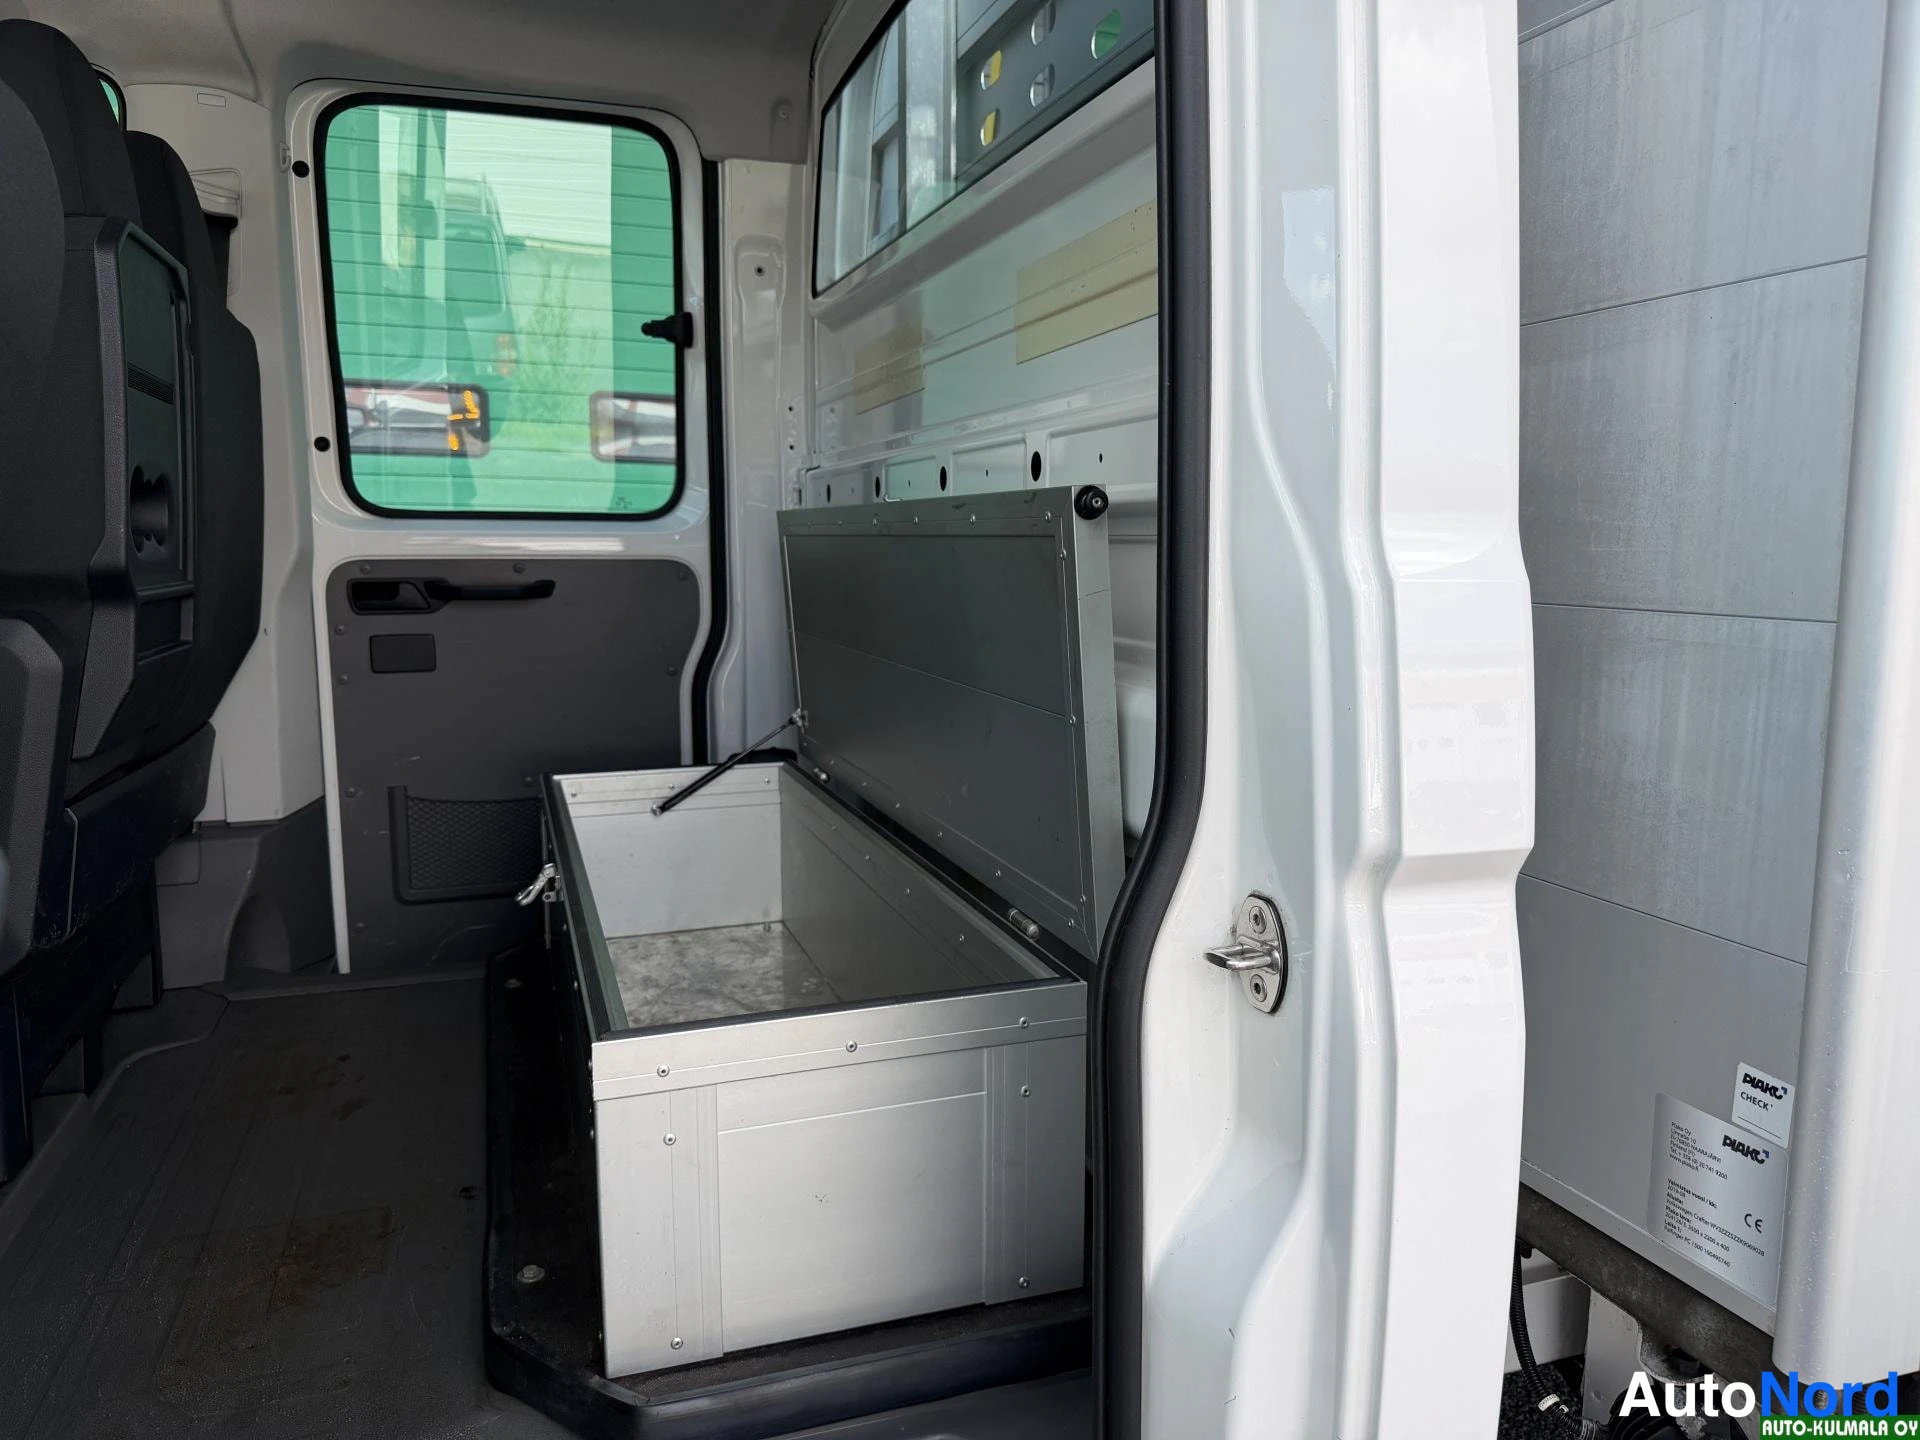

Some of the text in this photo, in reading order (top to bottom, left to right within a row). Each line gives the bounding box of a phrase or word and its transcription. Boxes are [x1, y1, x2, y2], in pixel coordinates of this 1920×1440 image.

[1741, 1091, 1768, 1111] CHECK
[1716, 1169, 1727, 1180] 9200
[1694, 1213, 1709, 1225] Crafter
